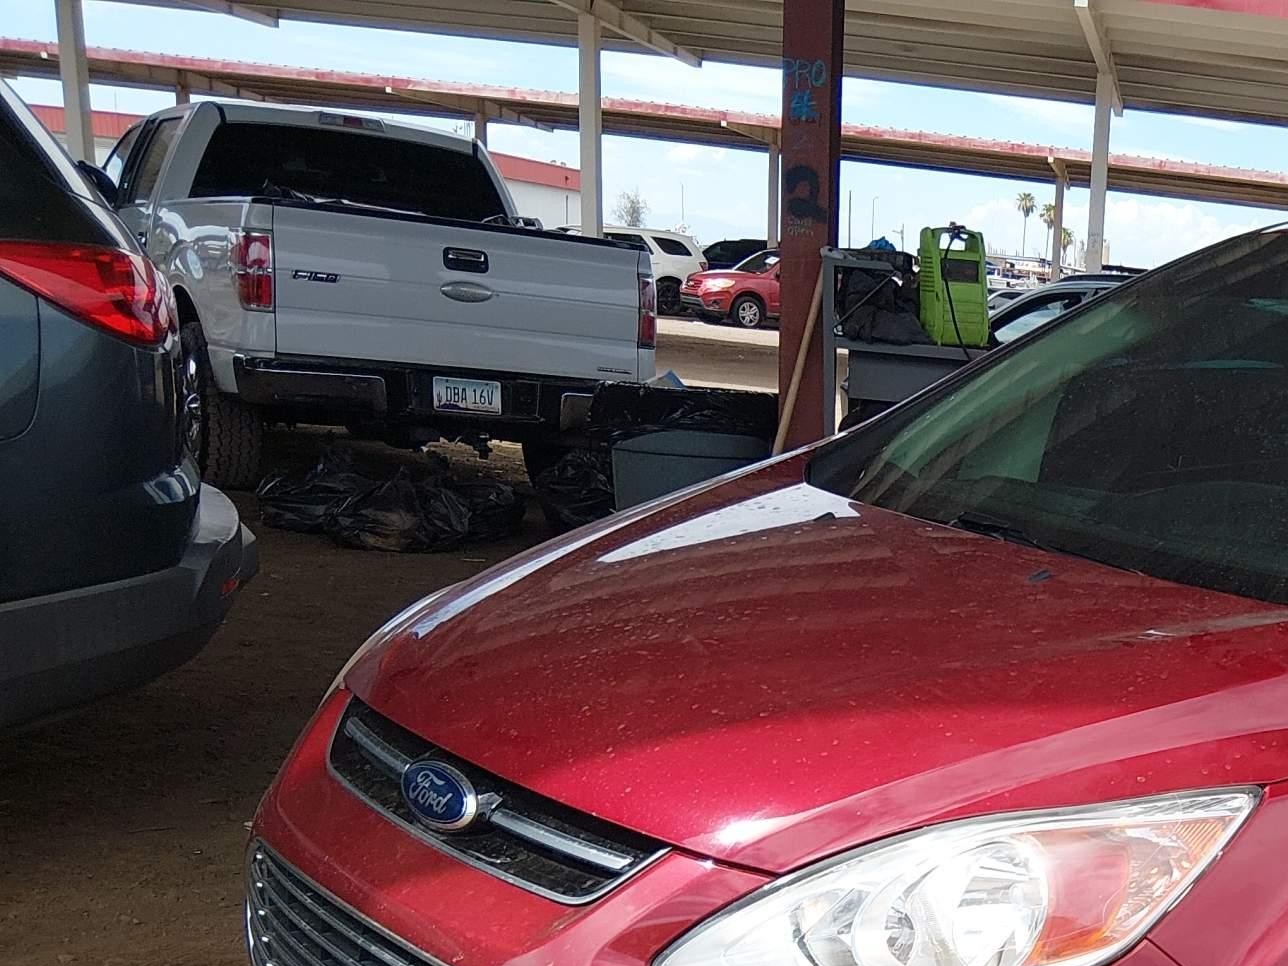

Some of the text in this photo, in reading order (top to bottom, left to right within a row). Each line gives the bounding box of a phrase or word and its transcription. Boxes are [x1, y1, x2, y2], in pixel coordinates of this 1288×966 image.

[783, 57, 828, 89] PRO
[784, 164, 828, 224] 2
[445, 385, 495, 406] DBA 16V
[408, 770, 454, 814] Ford
